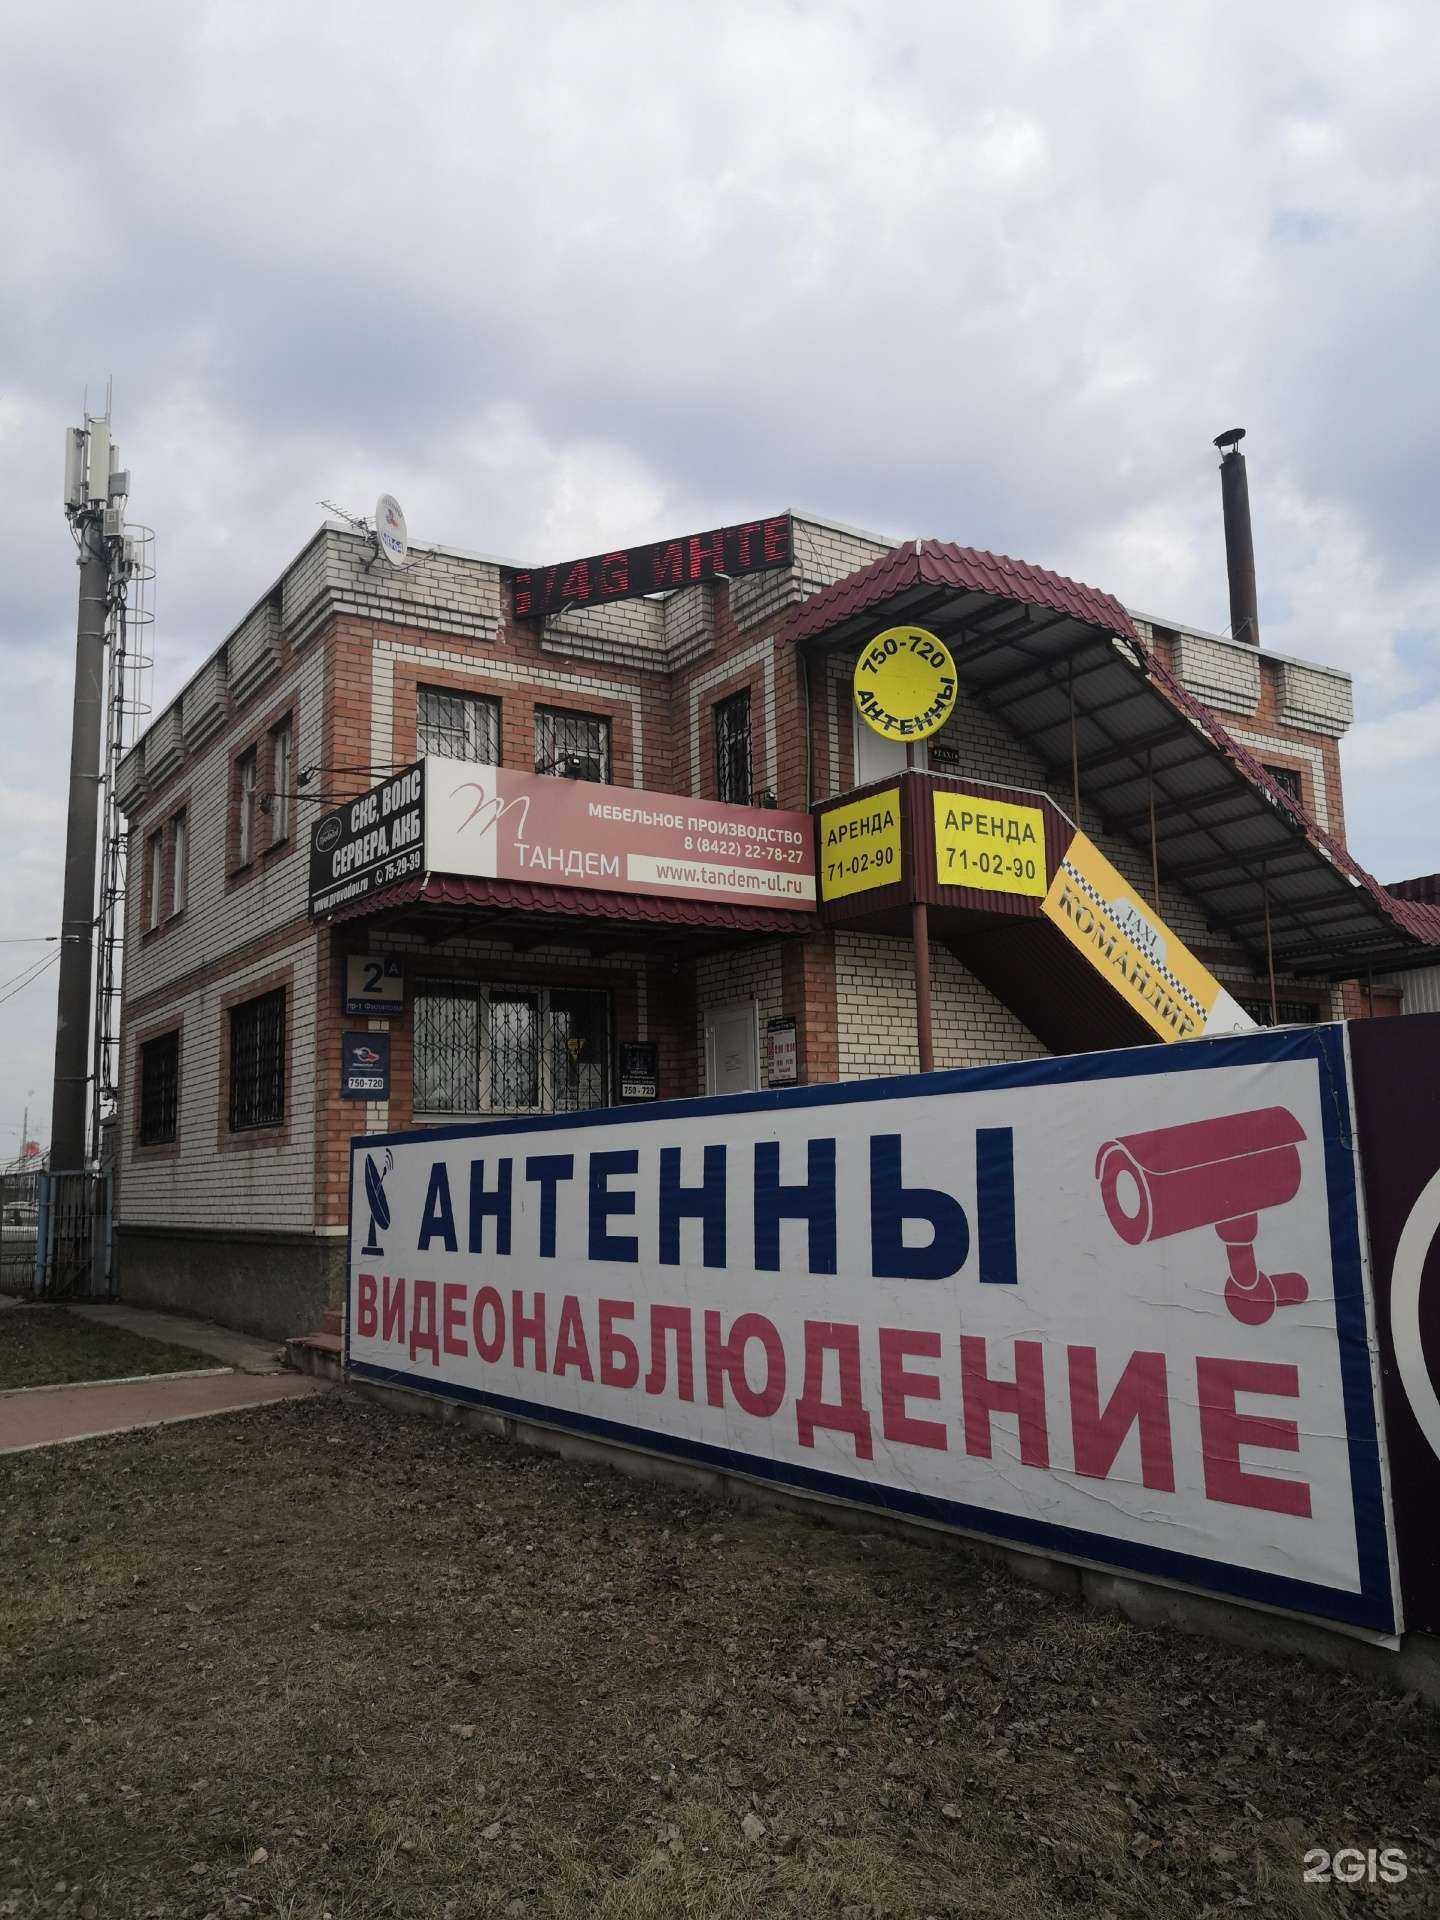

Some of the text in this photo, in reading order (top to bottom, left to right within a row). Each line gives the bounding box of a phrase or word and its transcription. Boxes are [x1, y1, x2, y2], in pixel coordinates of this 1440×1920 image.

[654, 518, 789, 586] ИНТЕ
[861, 635, 946, 675] 750-720
[857, 677, 955, 735] АНТЕННЫ
[351, 769, 421, 833] СКС, ВОЛС
[332, 827, 390, 879] СЕРВЕРА,
[392, 809, 421, 849] АКБ
[588, 803, 803, 845] МЕБЕЛЬНОЕ ПРОИЗВОДСТВО
[827, 810, 894, 846] АРЕНДА
[945, 809, 1036, 845] АРЕНДА
[385, 851, 420, 881] 75-29-39
[514, 842, 620, 878] ТАНДЕМ
[684, 837, 803, 864] 8 (8422) 22-78-27
[828, 846, 893, 881] 71-02-90
[946, 848, 1035, 880] 71-02-90
[656, 863, 802, 894] www.tandem-ul.ru
[1126, 906, 1159, 947] TAXI
[1058, 884, 1195, 1037] КОМАНДИР
[350, 1078, 383, 1088] 750-720
[418, 1126, 1018, 1285] АНТЕННЫ
[358, 1273, 1312, 1519] ВИДЕОНАБЛЮДЕНИЕ
